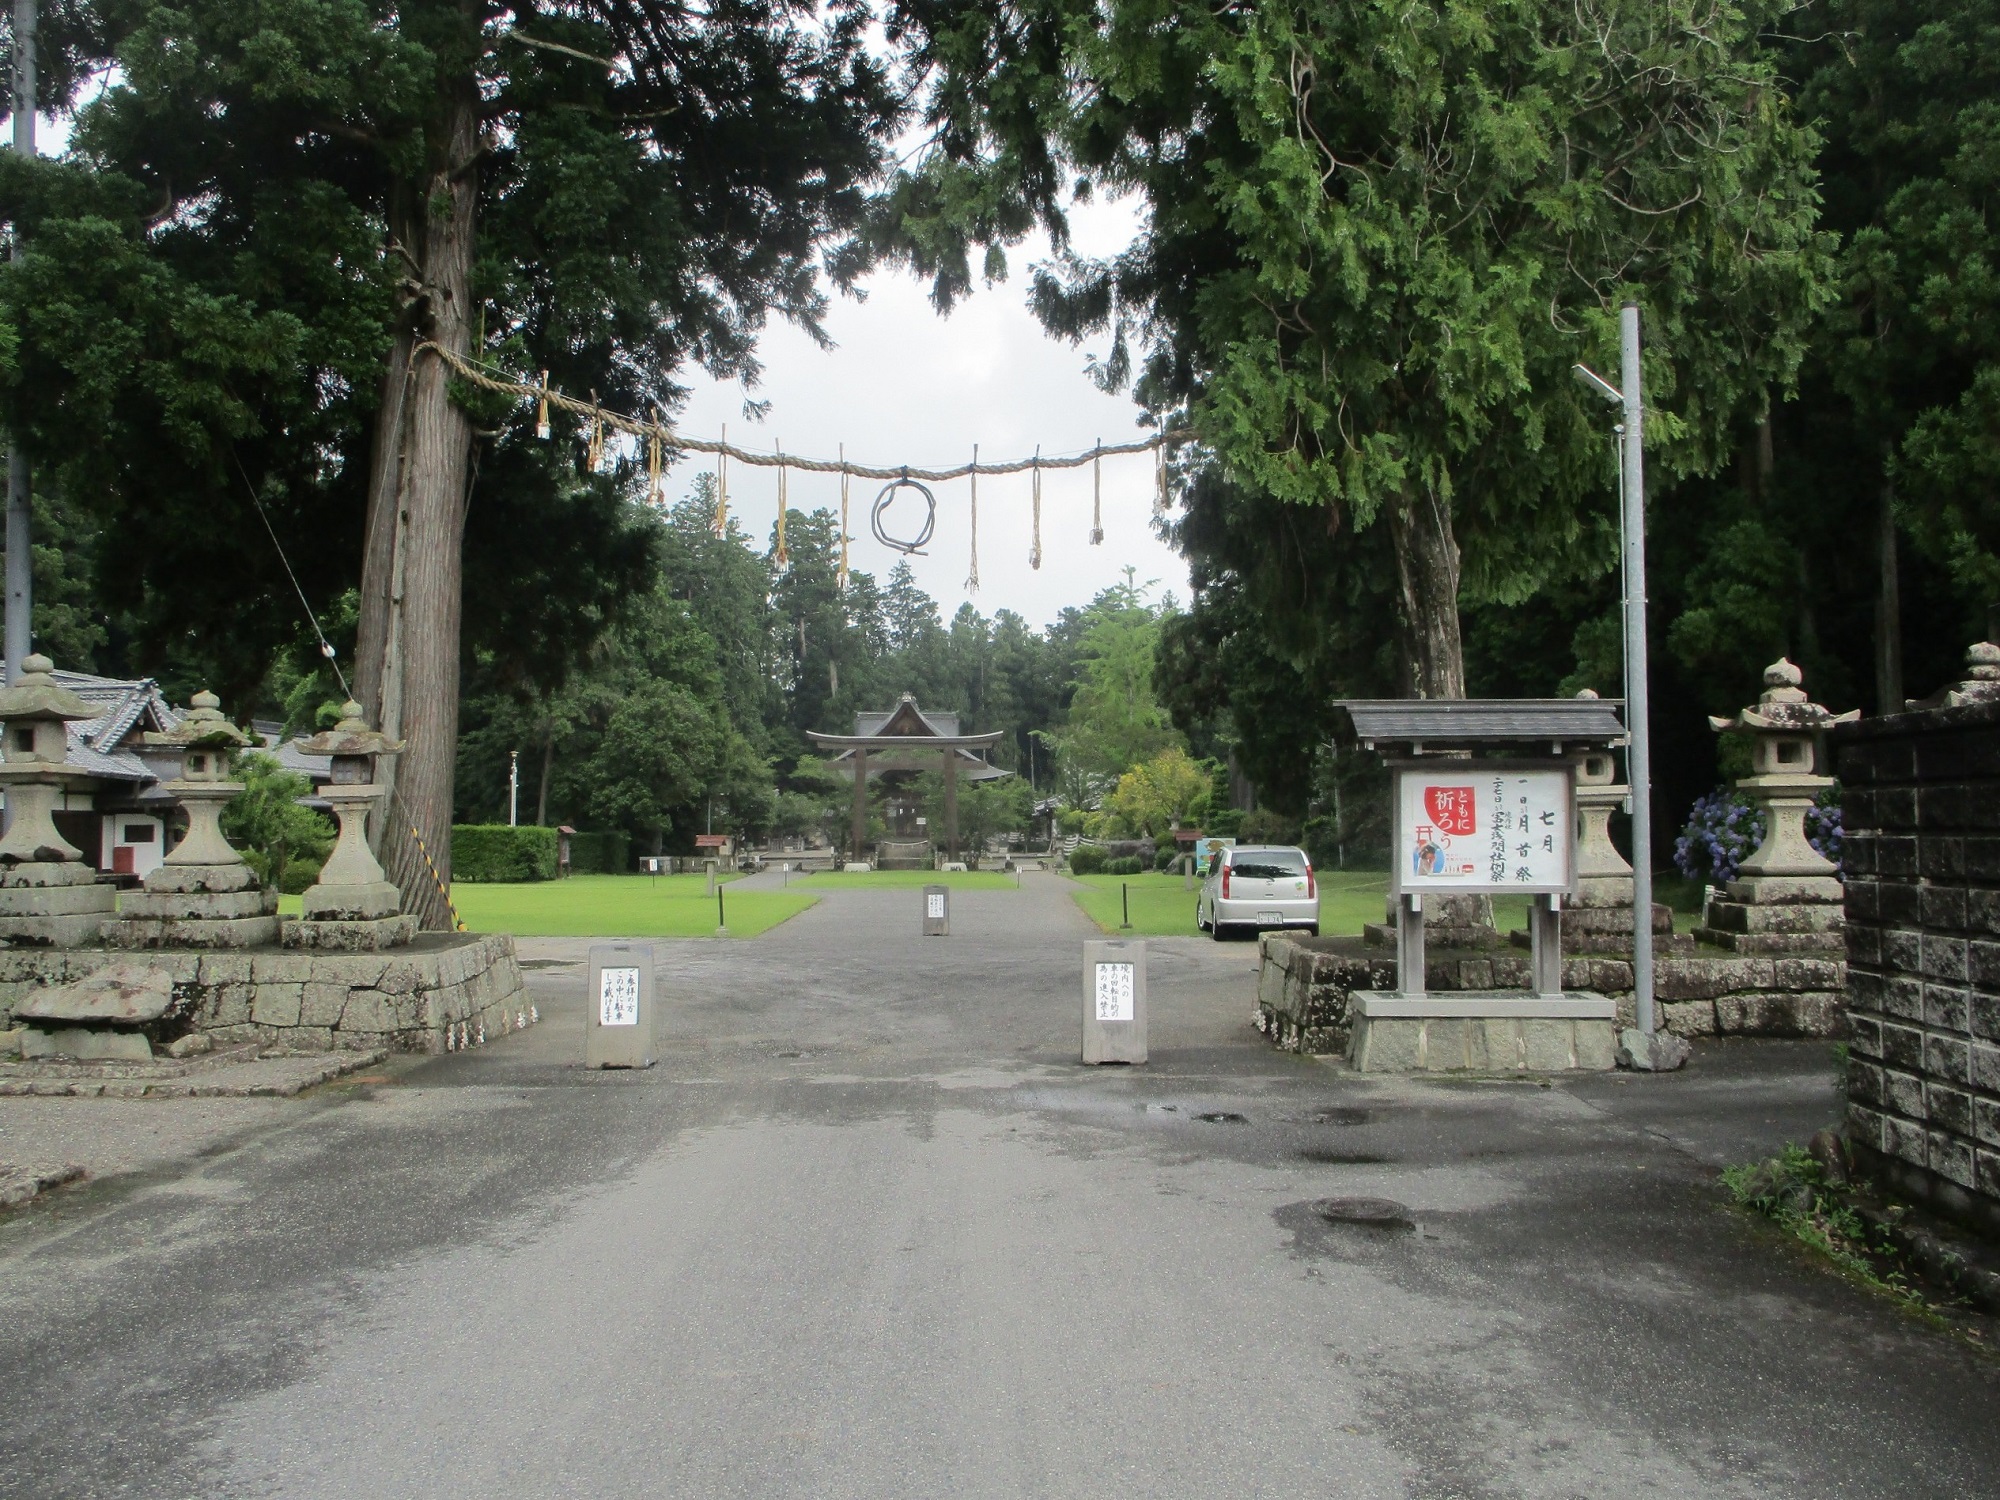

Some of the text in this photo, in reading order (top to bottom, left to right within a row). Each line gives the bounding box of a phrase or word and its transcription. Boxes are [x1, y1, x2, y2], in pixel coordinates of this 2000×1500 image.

[1434, 791, 1455, 850] 祈ろう
[1457, 790, 1470, 830] ともに
[1539, 810, 1555, 853] 七月
[1120, 964, 1130, 997] 境内への
